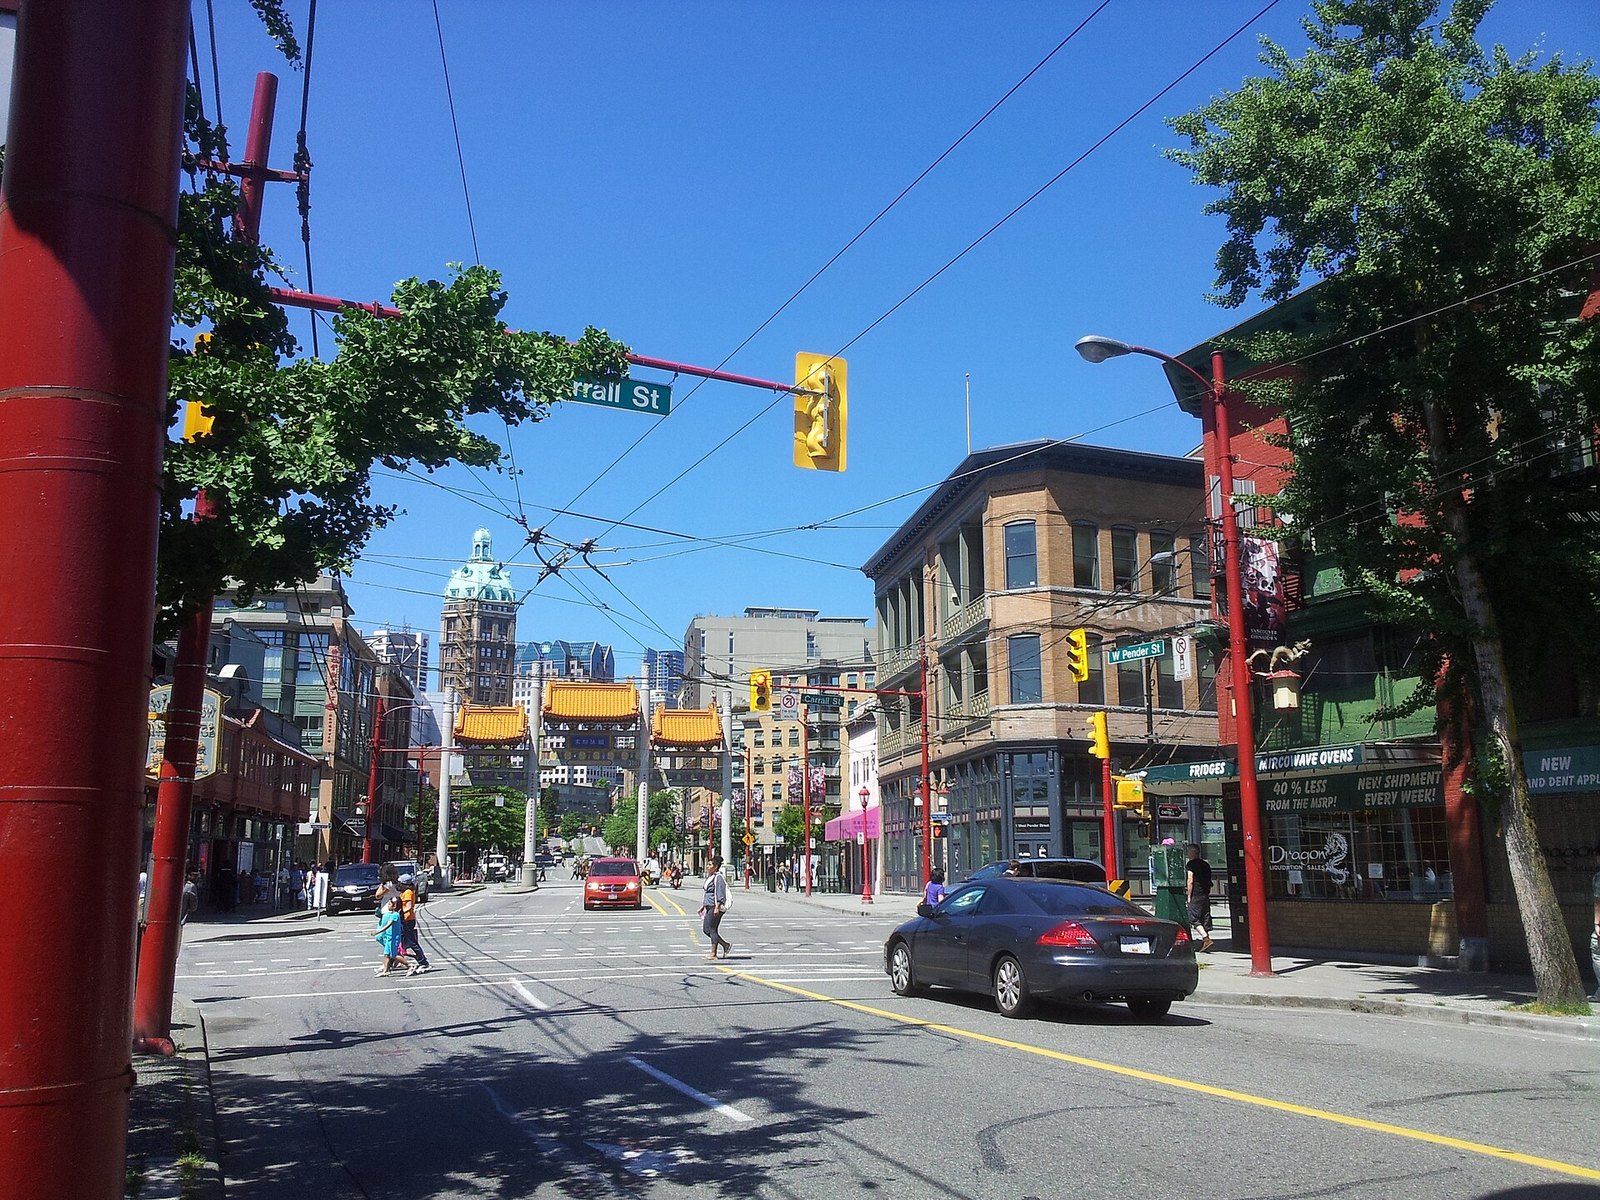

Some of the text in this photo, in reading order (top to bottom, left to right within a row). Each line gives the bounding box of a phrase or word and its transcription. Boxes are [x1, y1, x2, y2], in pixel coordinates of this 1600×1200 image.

[572, 380, 659, 410] rrall St
[1112, 643, 1161, 661] W Pender St
[1258, 748, 1354, 771] MIRCOWAVE OVENS
[1540, 756, 1571, 771] NEW
[1189, 761, 1226, 777] FRIDGES
[1273, 779, 1328, 795] 40 % LESS
[1383, 770, 1442, 789] SHIPMENT
[1548, 775, 1574, 787] DENT
[1576, 773, 1600, 786] APPL
[1266, 795, 1338, 811] FROM THE MSRP!
[1364, 787, 1436, 806] EVERY WEEK!
[1268, 845, 1326, 866] Dragon
[1306, 864, 1325, 872] SALES
